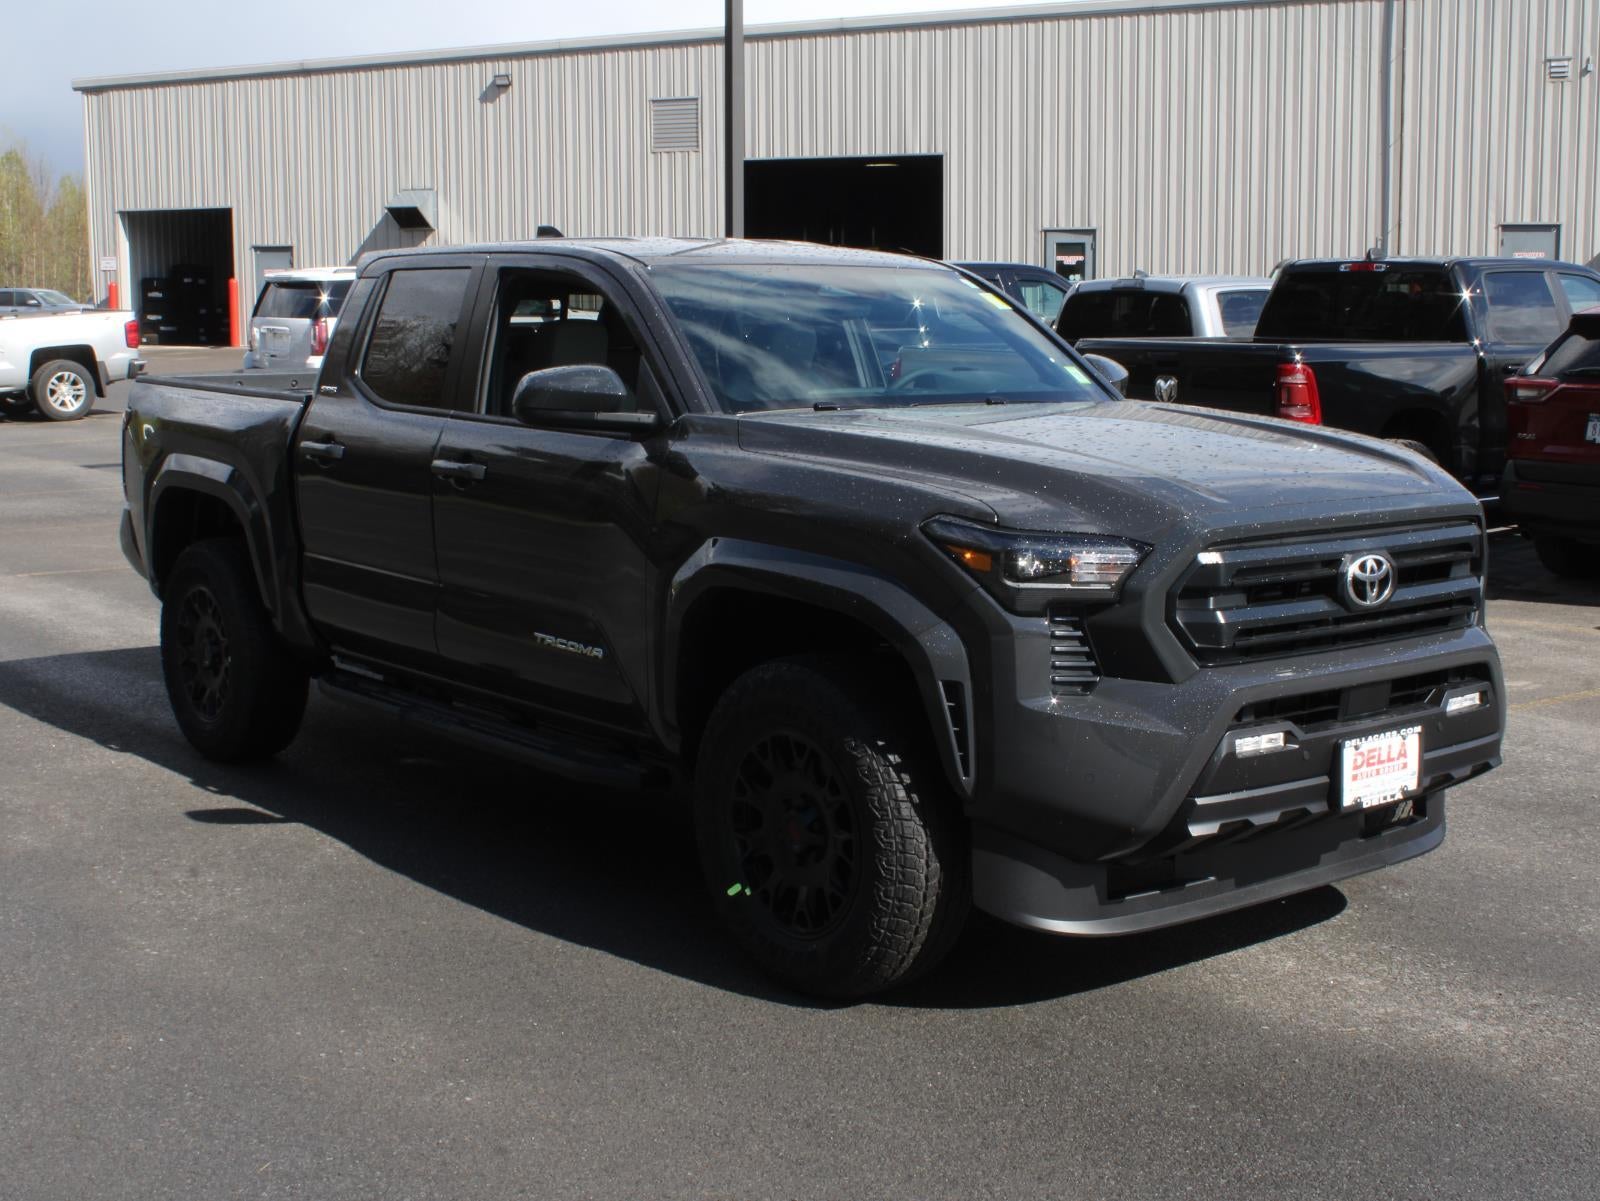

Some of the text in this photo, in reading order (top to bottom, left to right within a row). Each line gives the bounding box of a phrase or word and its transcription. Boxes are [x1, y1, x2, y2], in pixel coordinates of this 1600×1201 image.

[533, 631, 604, 659] TACOMA
[1345, 725, 1422, 748] DELLACARS.COM
[1352, 741, 1408, 771] DELLA
[1362, 791, 1404, 808] DELLA
